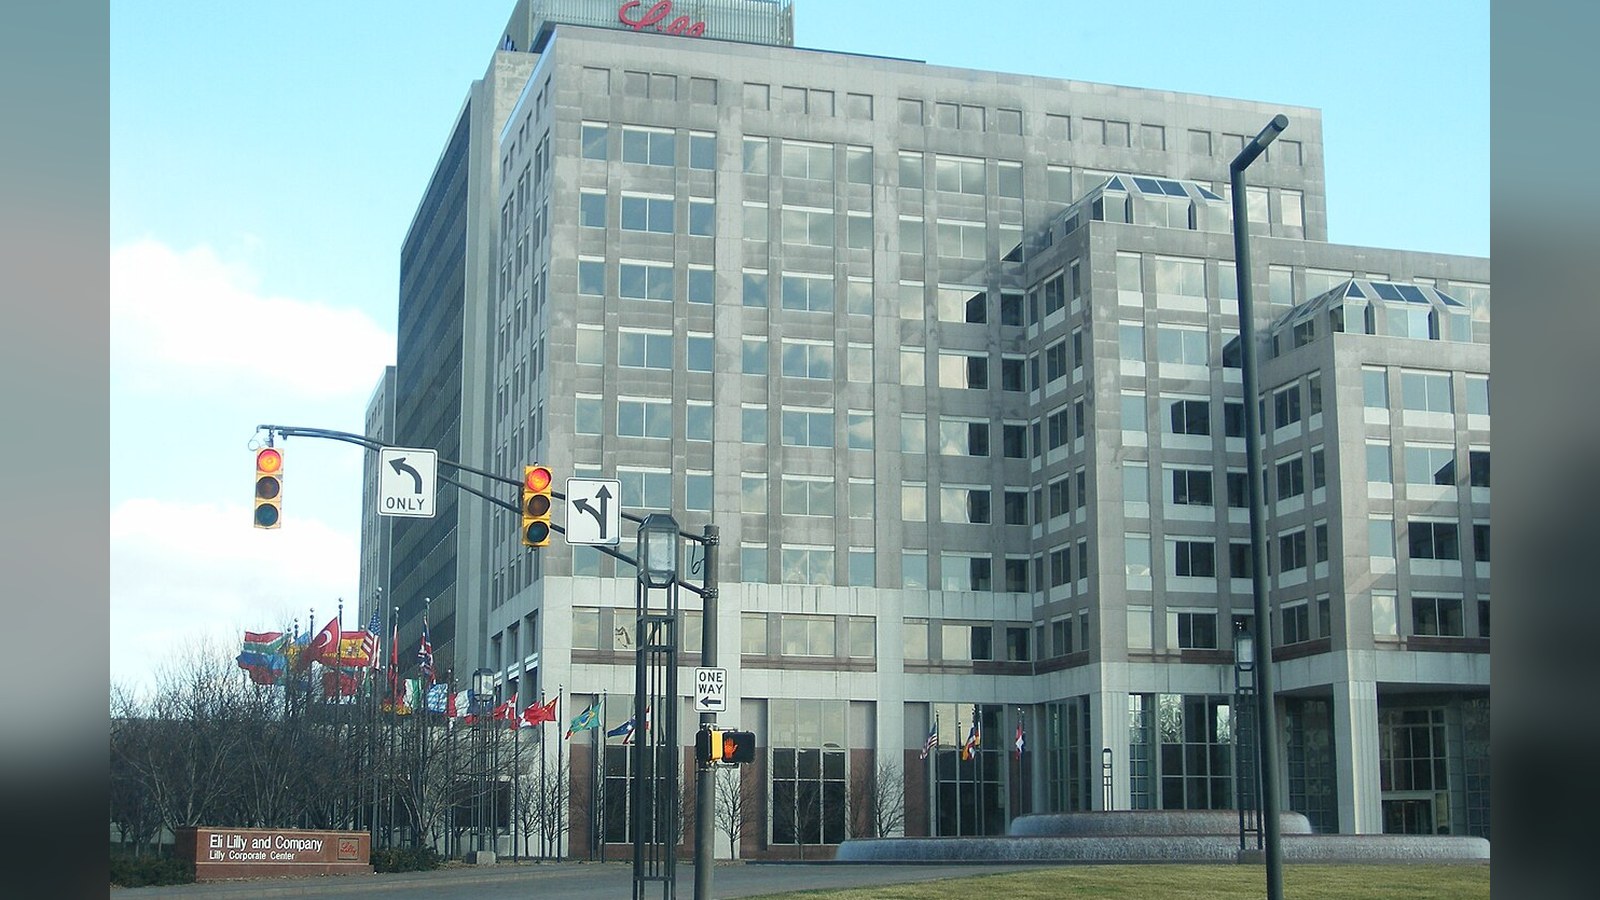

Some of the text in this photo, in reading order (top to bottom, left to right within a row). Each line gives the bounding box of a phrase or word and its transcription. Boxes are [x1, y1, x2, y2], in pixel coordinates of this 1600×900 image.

[386, 497, 425, 510] ONLY
[699, 671, 722, 682] ONE
[698, 684, 723, 694] WAY
[210, 834, 323, 852] Eli Lilly and Company
[210, 850, 295, 861] Lilly Corporate Center
